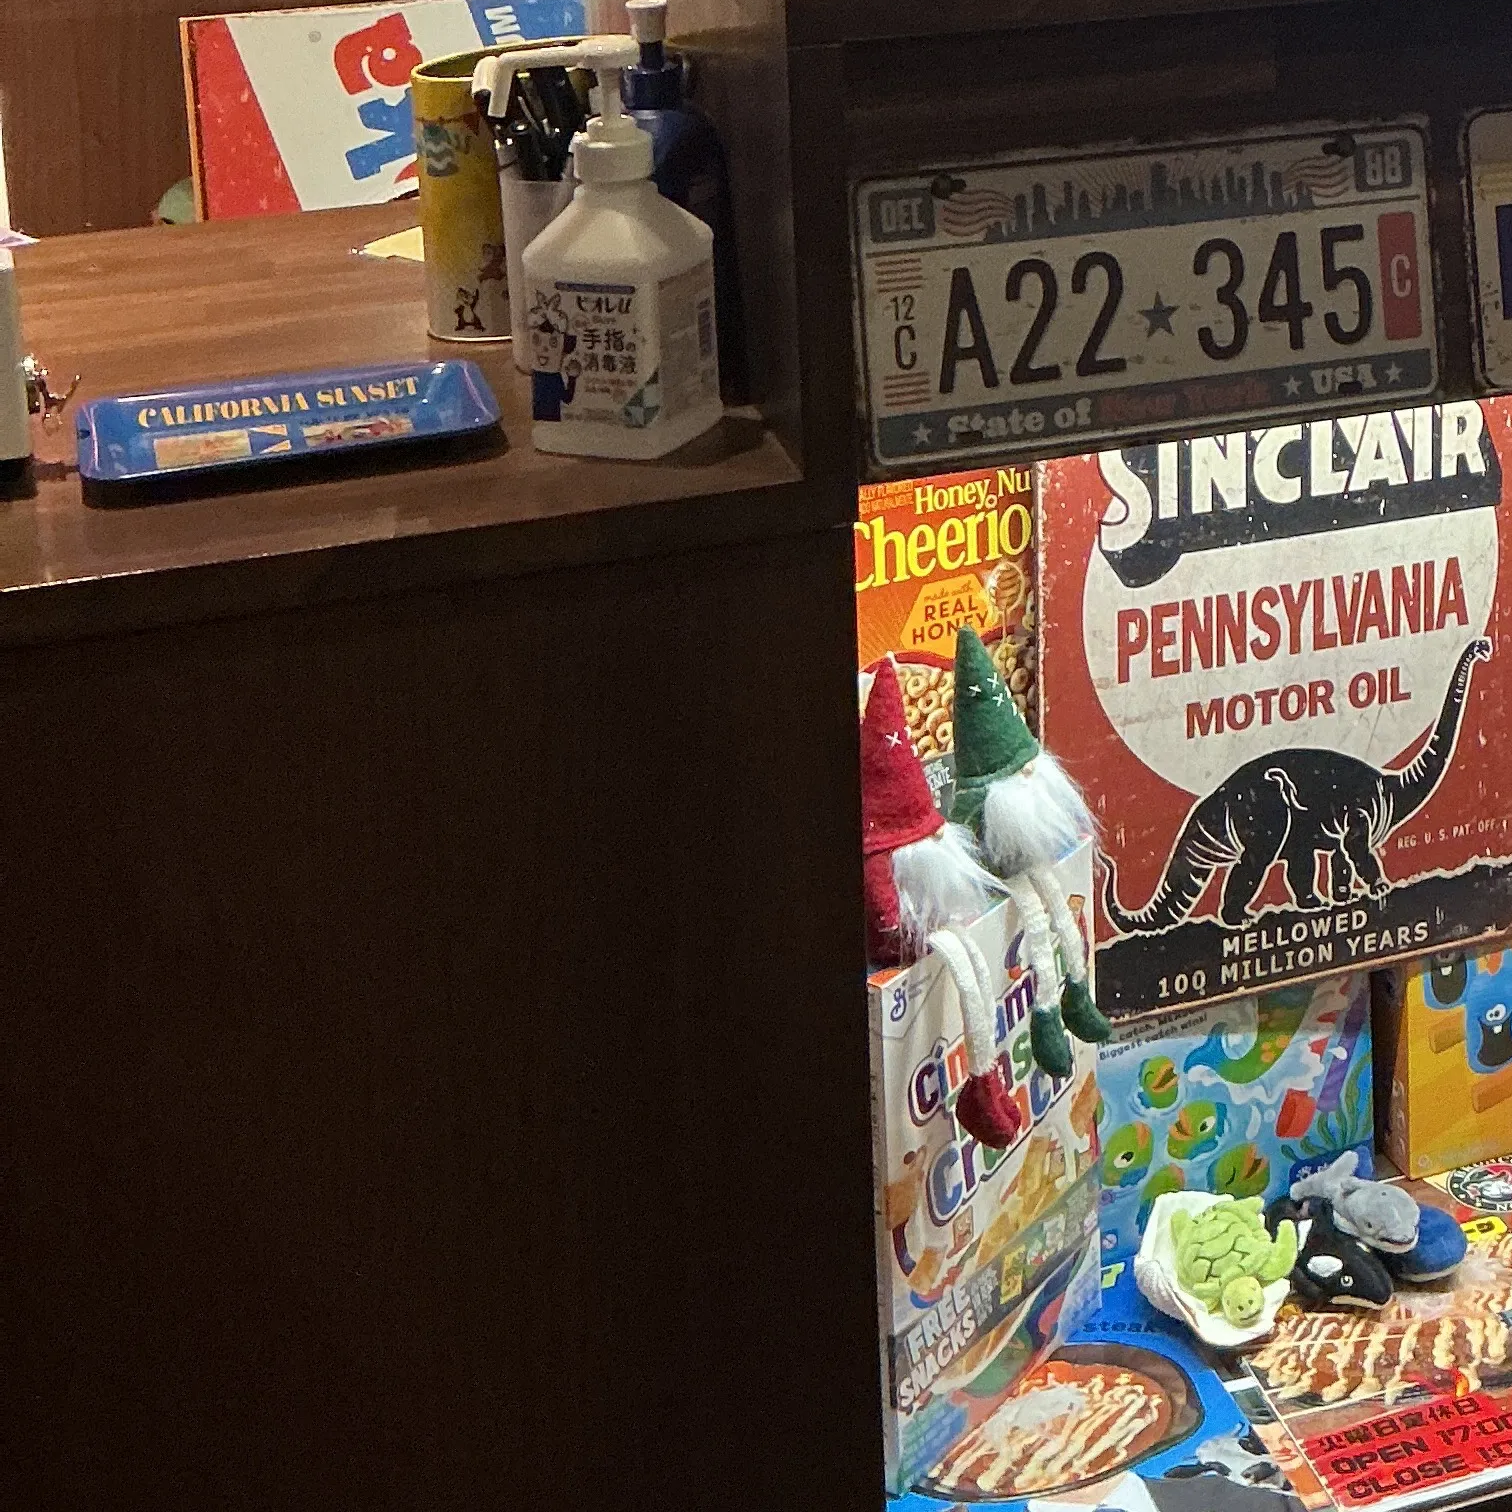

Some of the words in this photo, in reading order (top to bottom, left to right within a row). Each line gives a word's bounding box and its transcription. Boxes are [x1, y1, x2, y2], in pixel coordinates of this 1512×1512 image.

[890, 294, 915, 321] 12
[939, 252, 1127, 393] A22
[1193, 224, 1373, 362] 345
[583, 329, 636, 352] 手指の
[584, 354, 637, 375] 消毒液
[138, 392, 309, 428] CALIFORNIA
[317, 376, 419, 408] SUNSET
[947, 408, 1046, 443] State
[1054, 398, 1093, 431] of
[1311, 364, 1377, 396] USA
[914, 479, 991, 514] Honey
[1100, 400, 1487, 551] SINCLAIR
[913, 611, 988, 645] HONEY
[925, 595, 978, 622] REAL
[1117, 556, 1469, 683] PENNSYLVANIA
[1185, 684, 1335, 739] MOTOR
[1349, 667, 1411, 707] OIL
[1223, 910, 1368, 958] MELLOWED
[1158, 970, 1207, 998] 100
[1221, 943, 1333, 985] MILLION
[1347, 922, 1429, 956] YEARS
[906, 1291, 970, 1364] FREE
[899, 1309, 977, 1410] SNACKS
[1330, 1437, 1428, 1476] OPEN
[1346, 1453, 1465, 1500] CLOSE
